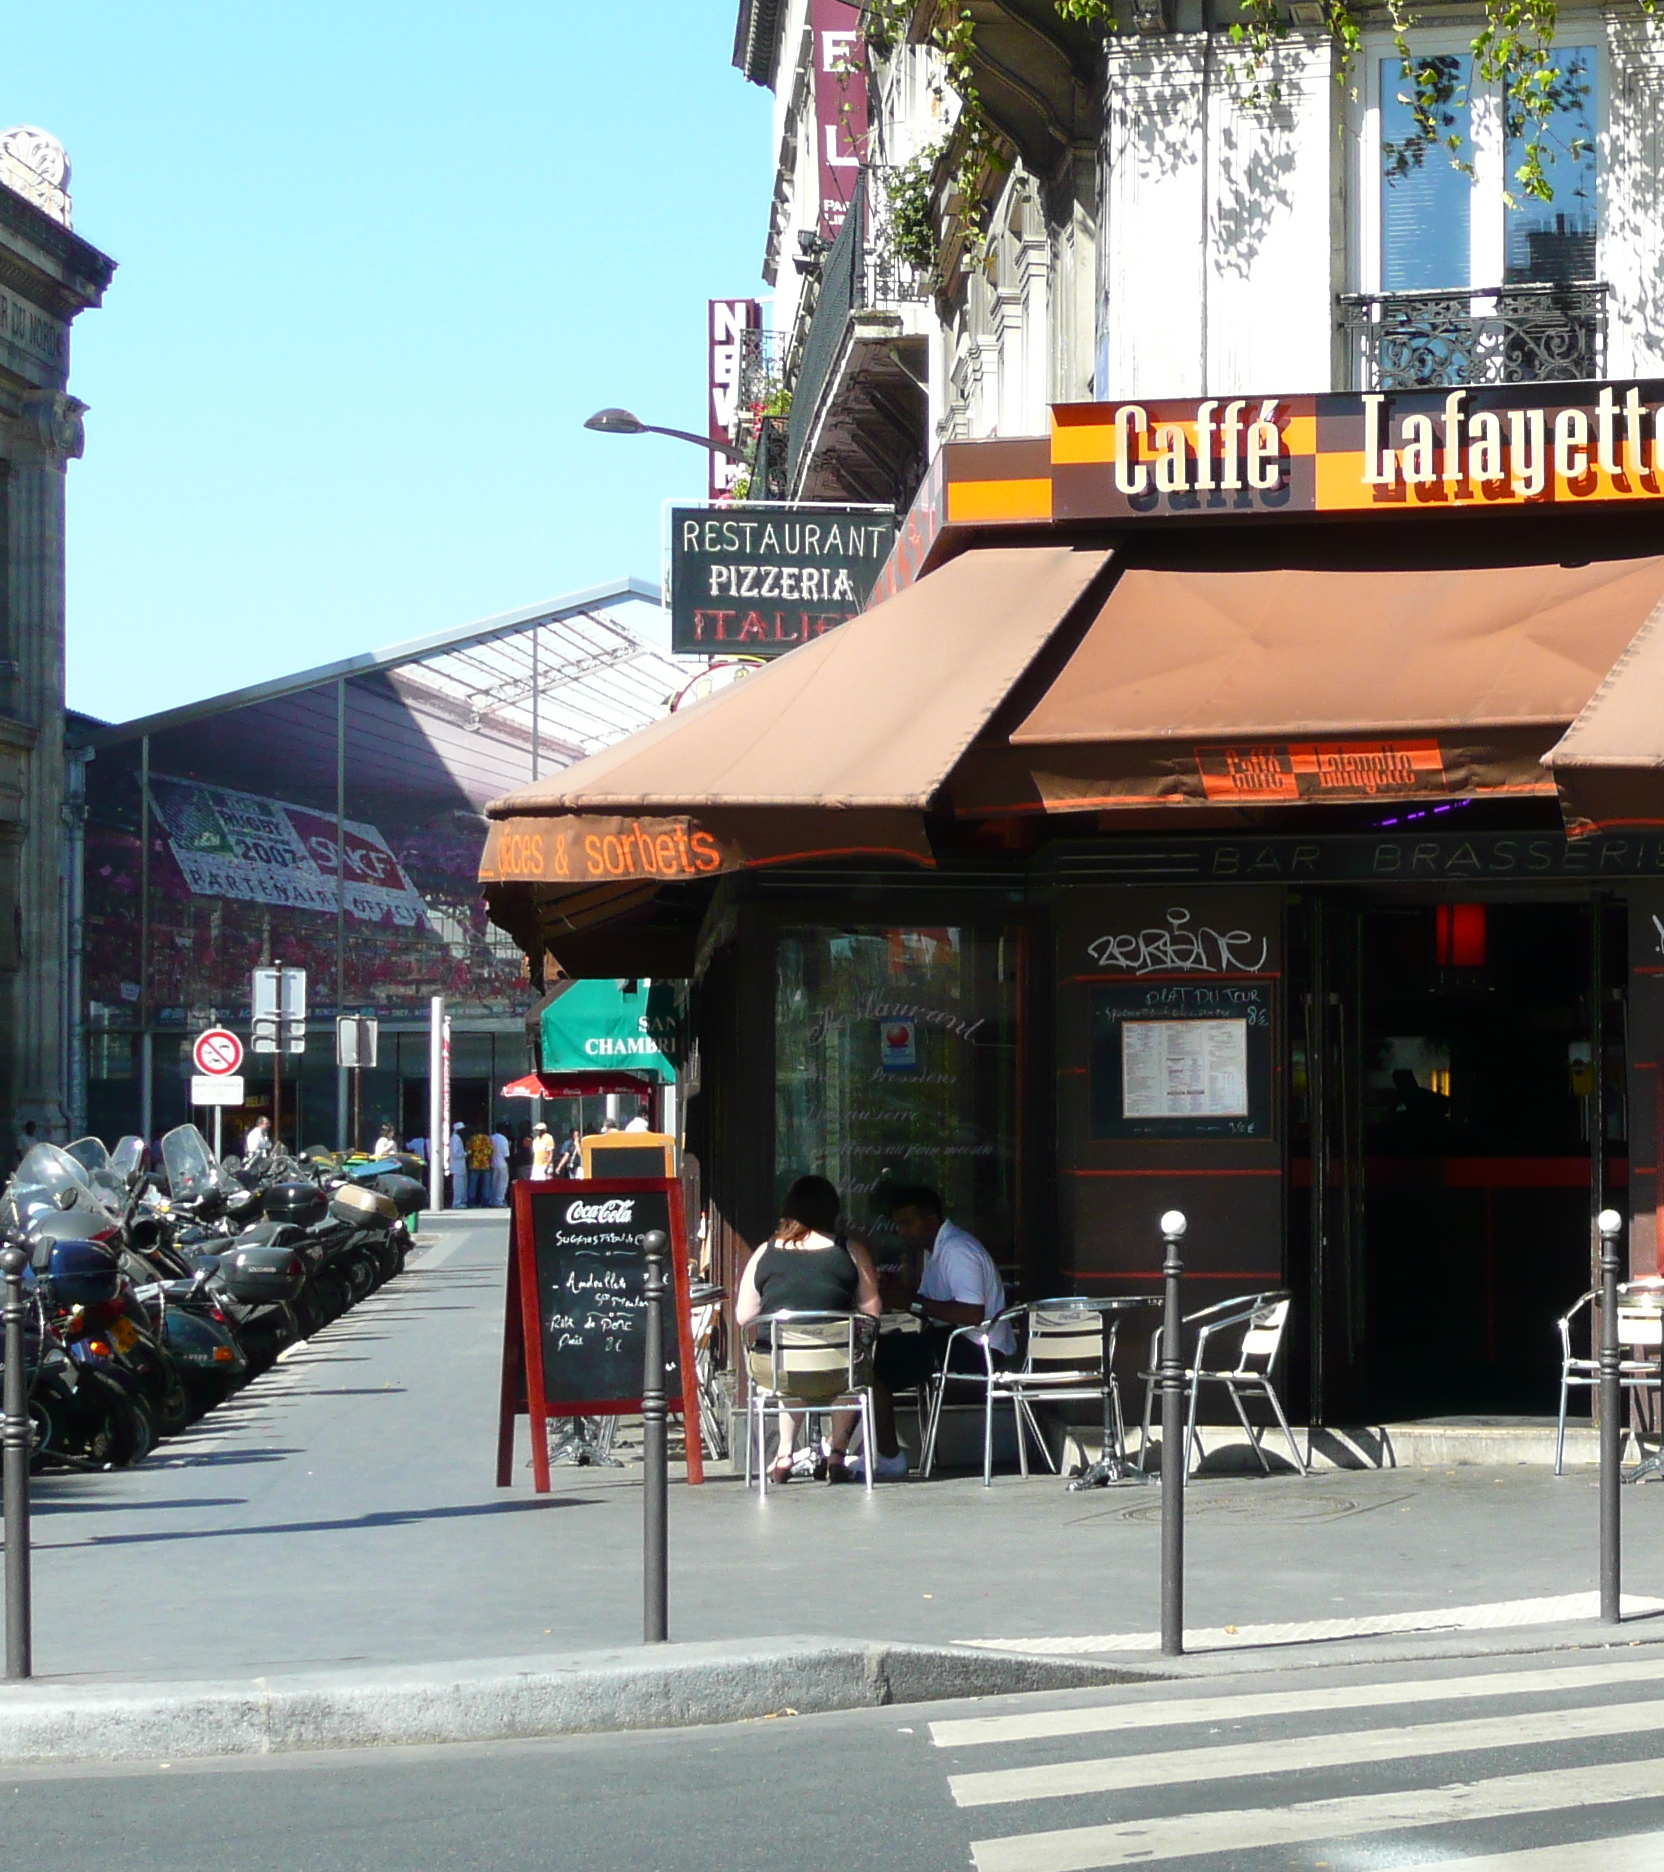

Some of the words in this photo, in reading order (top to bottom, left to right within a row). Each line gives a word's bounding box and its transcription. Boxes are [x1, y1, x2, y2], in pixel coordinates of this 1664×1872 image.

[1114, 400, 1280, 495] Caffé
[683, 520, 888, 558] RESTAURANT
[709, 564, 854, 602] PIZZERIA
[694, 608, 857, 642] ITALIE
[217, 809, 285, 837] RUGBY
[236, 841, 298, 867] 2007
[555, 834, 570, 875] &
[585, 822, 721, 876] sorbets
[1212, 845, 1320, 874] BAR
[566, 1199, 635, 1224] Coca-Cola
